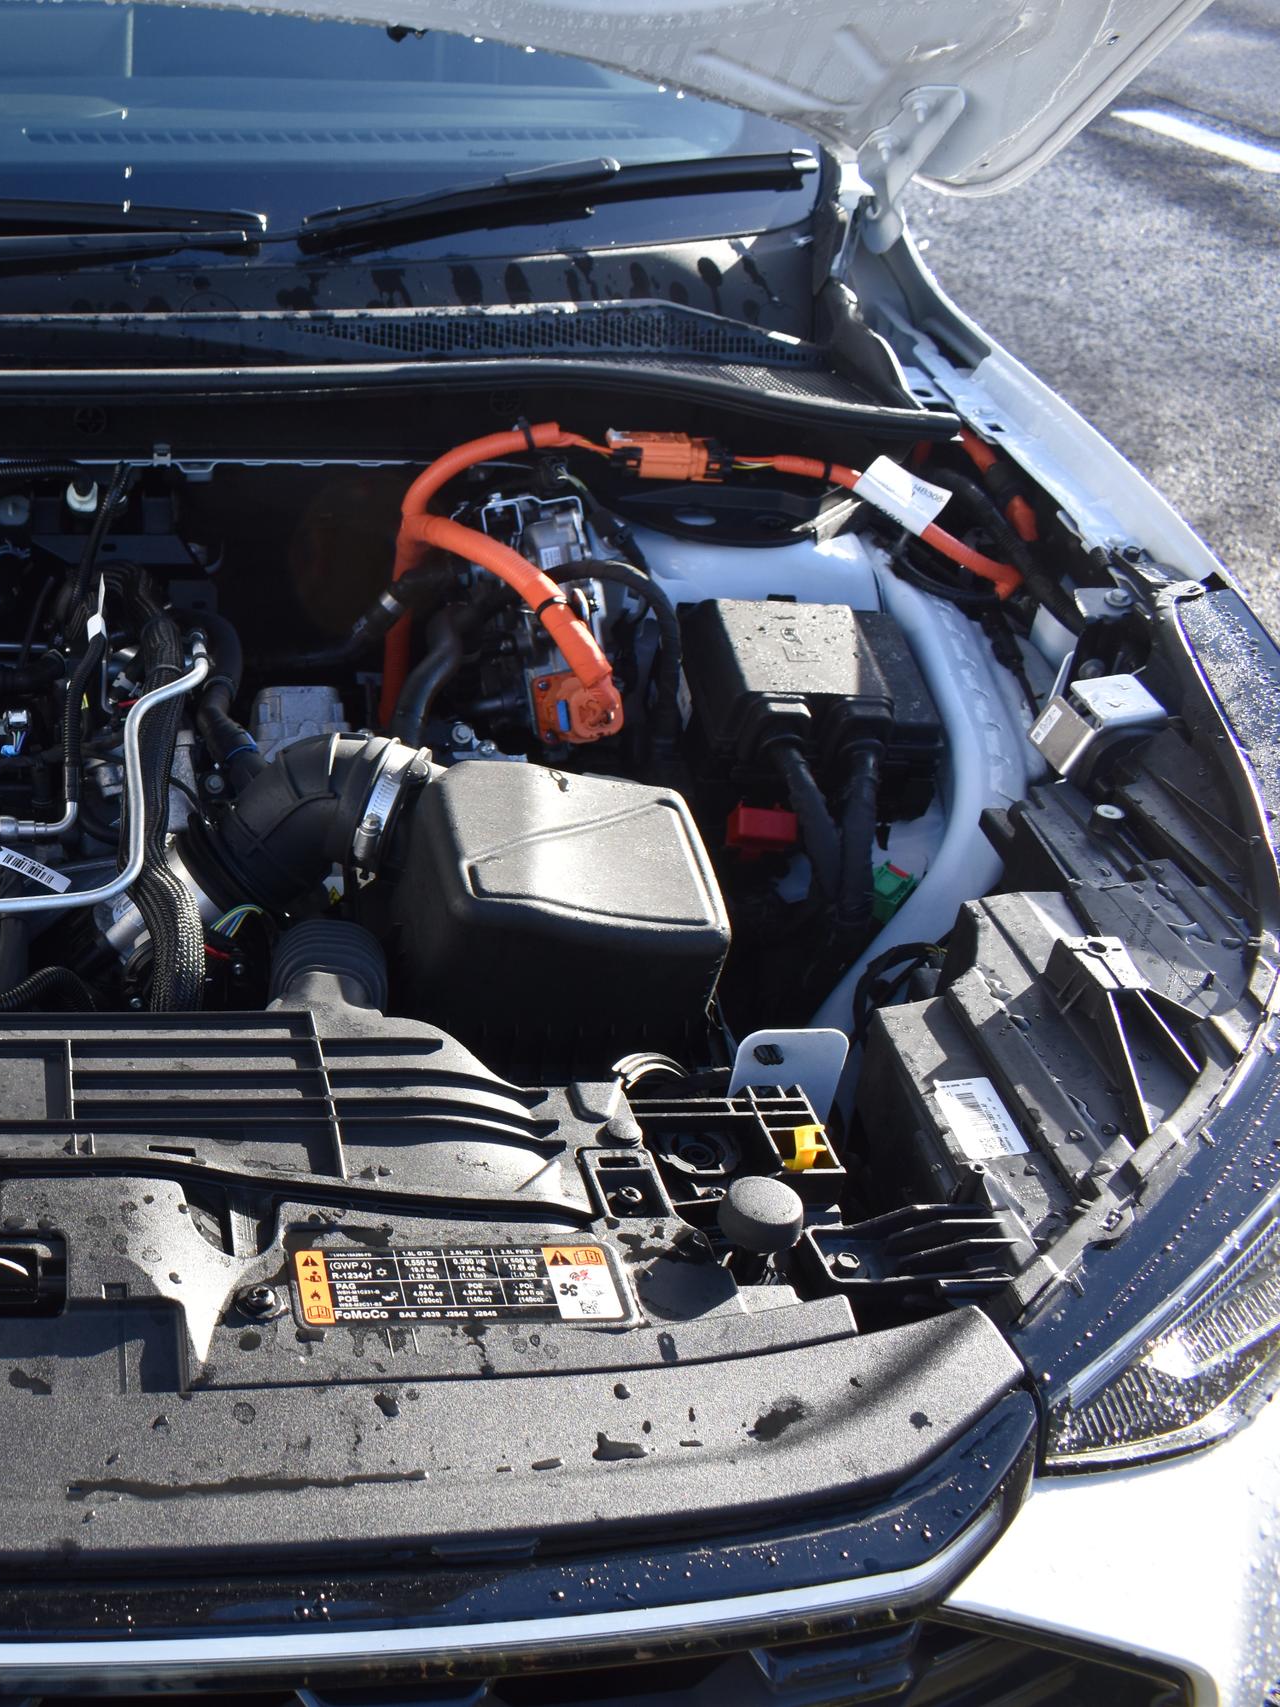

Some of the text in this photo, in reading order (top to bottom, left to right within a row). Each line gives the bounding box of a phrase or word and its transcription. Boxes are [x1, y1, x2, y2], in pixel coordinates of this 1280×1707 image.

[404, 1259, 438, 1267] 0.550 kg
[475, 1258, 487, 1266] kg
[526, 1257, 537, 1265] kg
[329, 1262, 372, 1271] (GWP 4)
[332, 1272, 373, 1280] R-1234yf
[334, 1310, 389, 1320] FoMoCo
